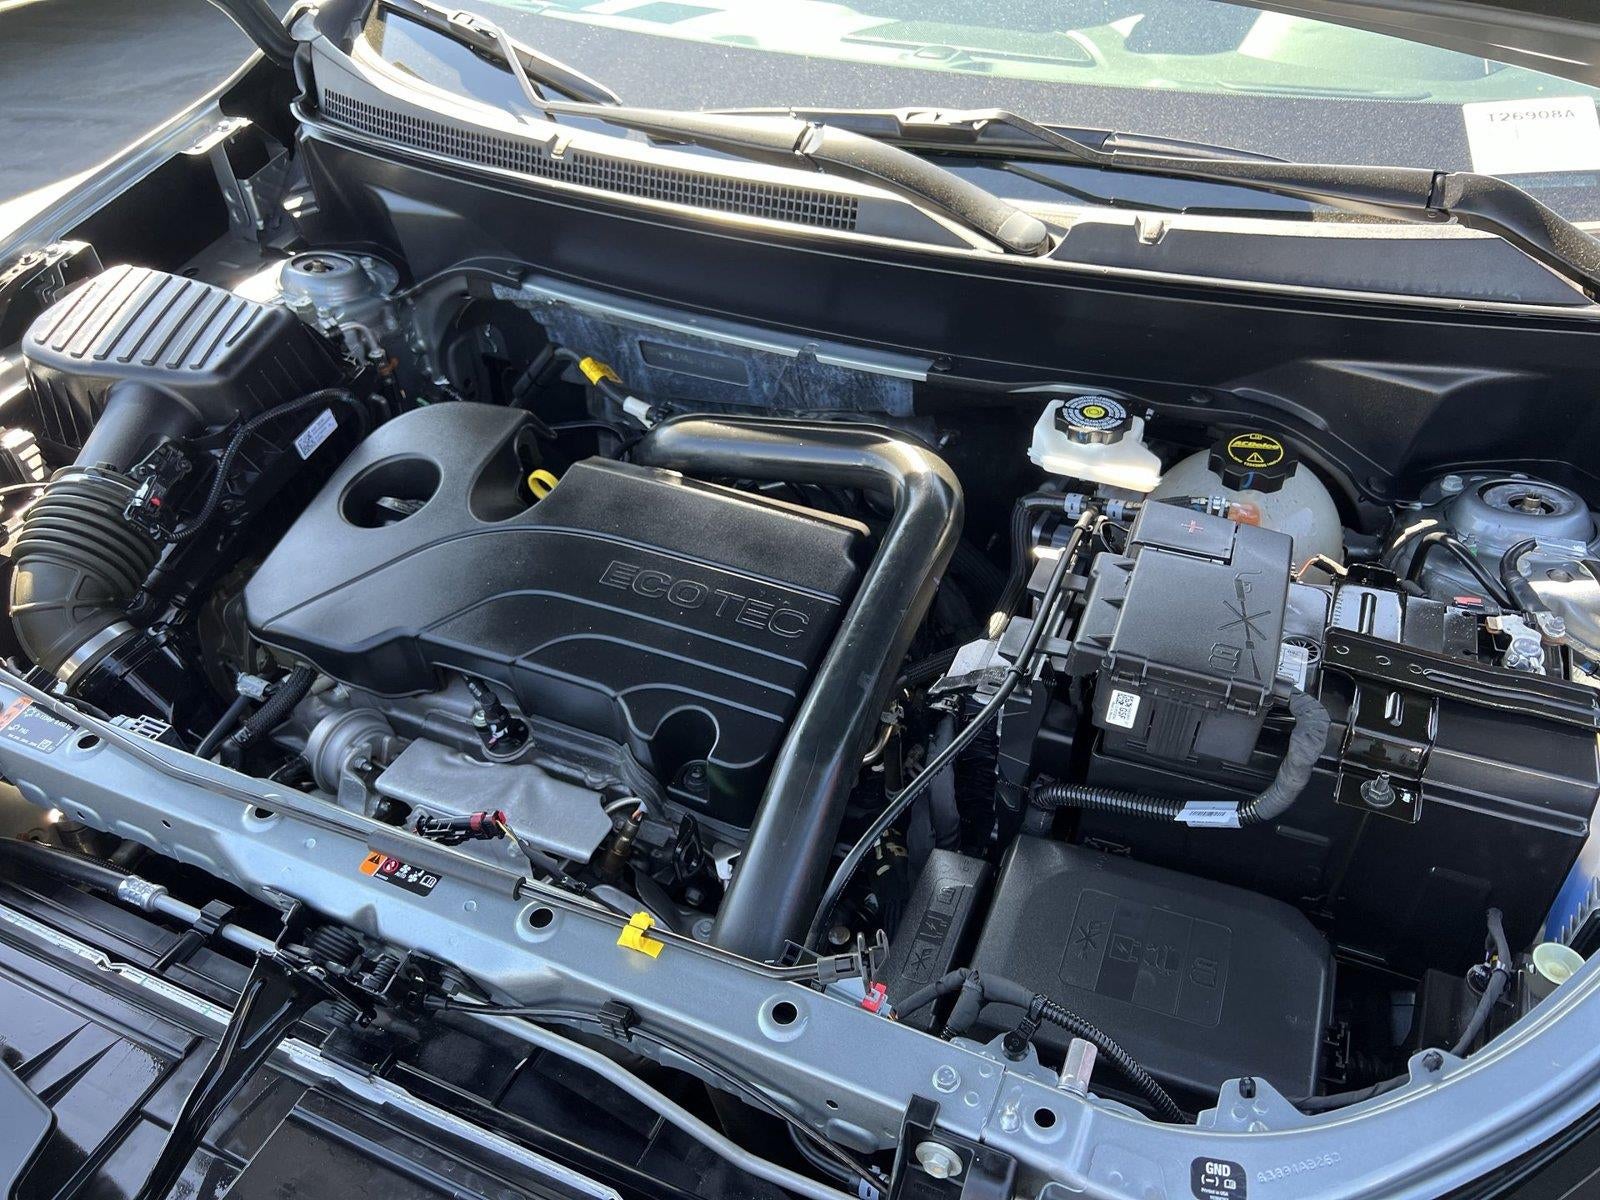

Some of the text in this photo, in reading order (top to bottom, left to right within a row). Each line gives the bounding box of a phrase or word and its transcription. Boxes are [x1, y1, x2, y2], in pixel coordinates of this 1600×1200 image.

[1231, 440, 1280, 450] ACDelco
[599, 560, 811, 638] ECOTEC
[1205, 1161, 1231, 1177] GND
